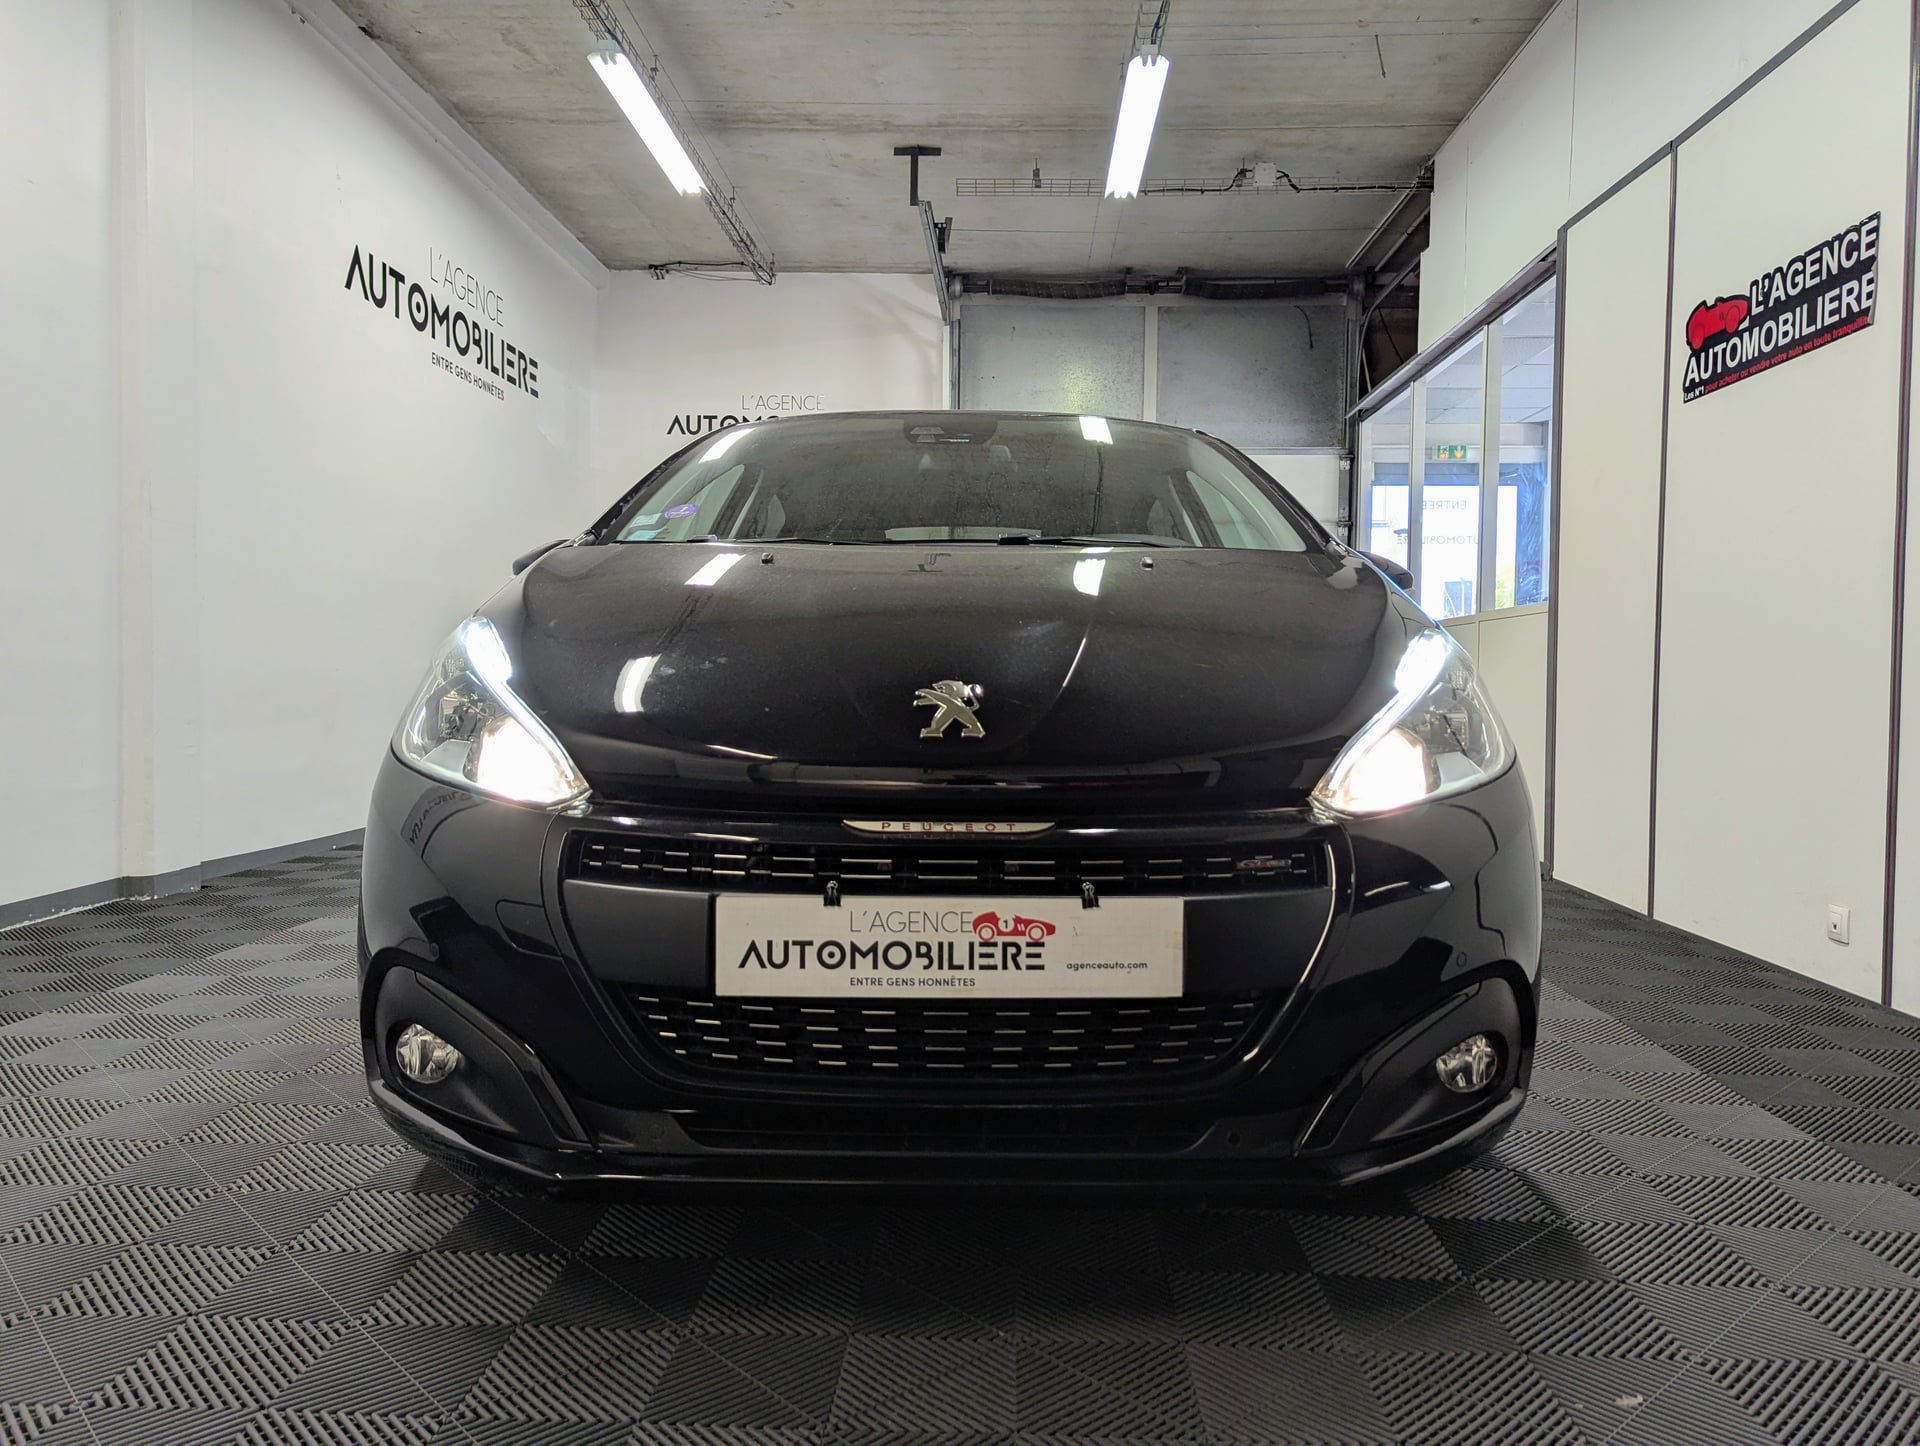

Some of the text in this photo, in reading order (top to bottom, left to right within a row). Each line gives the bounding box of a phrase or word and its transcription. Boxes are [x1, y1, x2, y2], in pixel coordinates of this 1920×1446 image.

[1751, 218, 1878, 316] L'AGENCE
[430, 247, 504, 328] L'AGENCE
[344, 244, 539, 399] AUTOMOBILIERE
[1685, 271, 1875, 387] AUTOMOBILIERE
[431, 352, 453, 374] ENTRE
[455, 365, 472, 384] GENS
[742, 394, 824, 410] L'AGENCE
[881, 822, 1016, 831] PEUGEOT
[850, 911, 974, 933] L'AGENCE
[738, 940, 1045, 970] AUTOMOBILIERE
[1066, 961, 1148, 971] agenceauto.com
[850, 975, 976, 987] ENTRE GENS HONNÊTES
